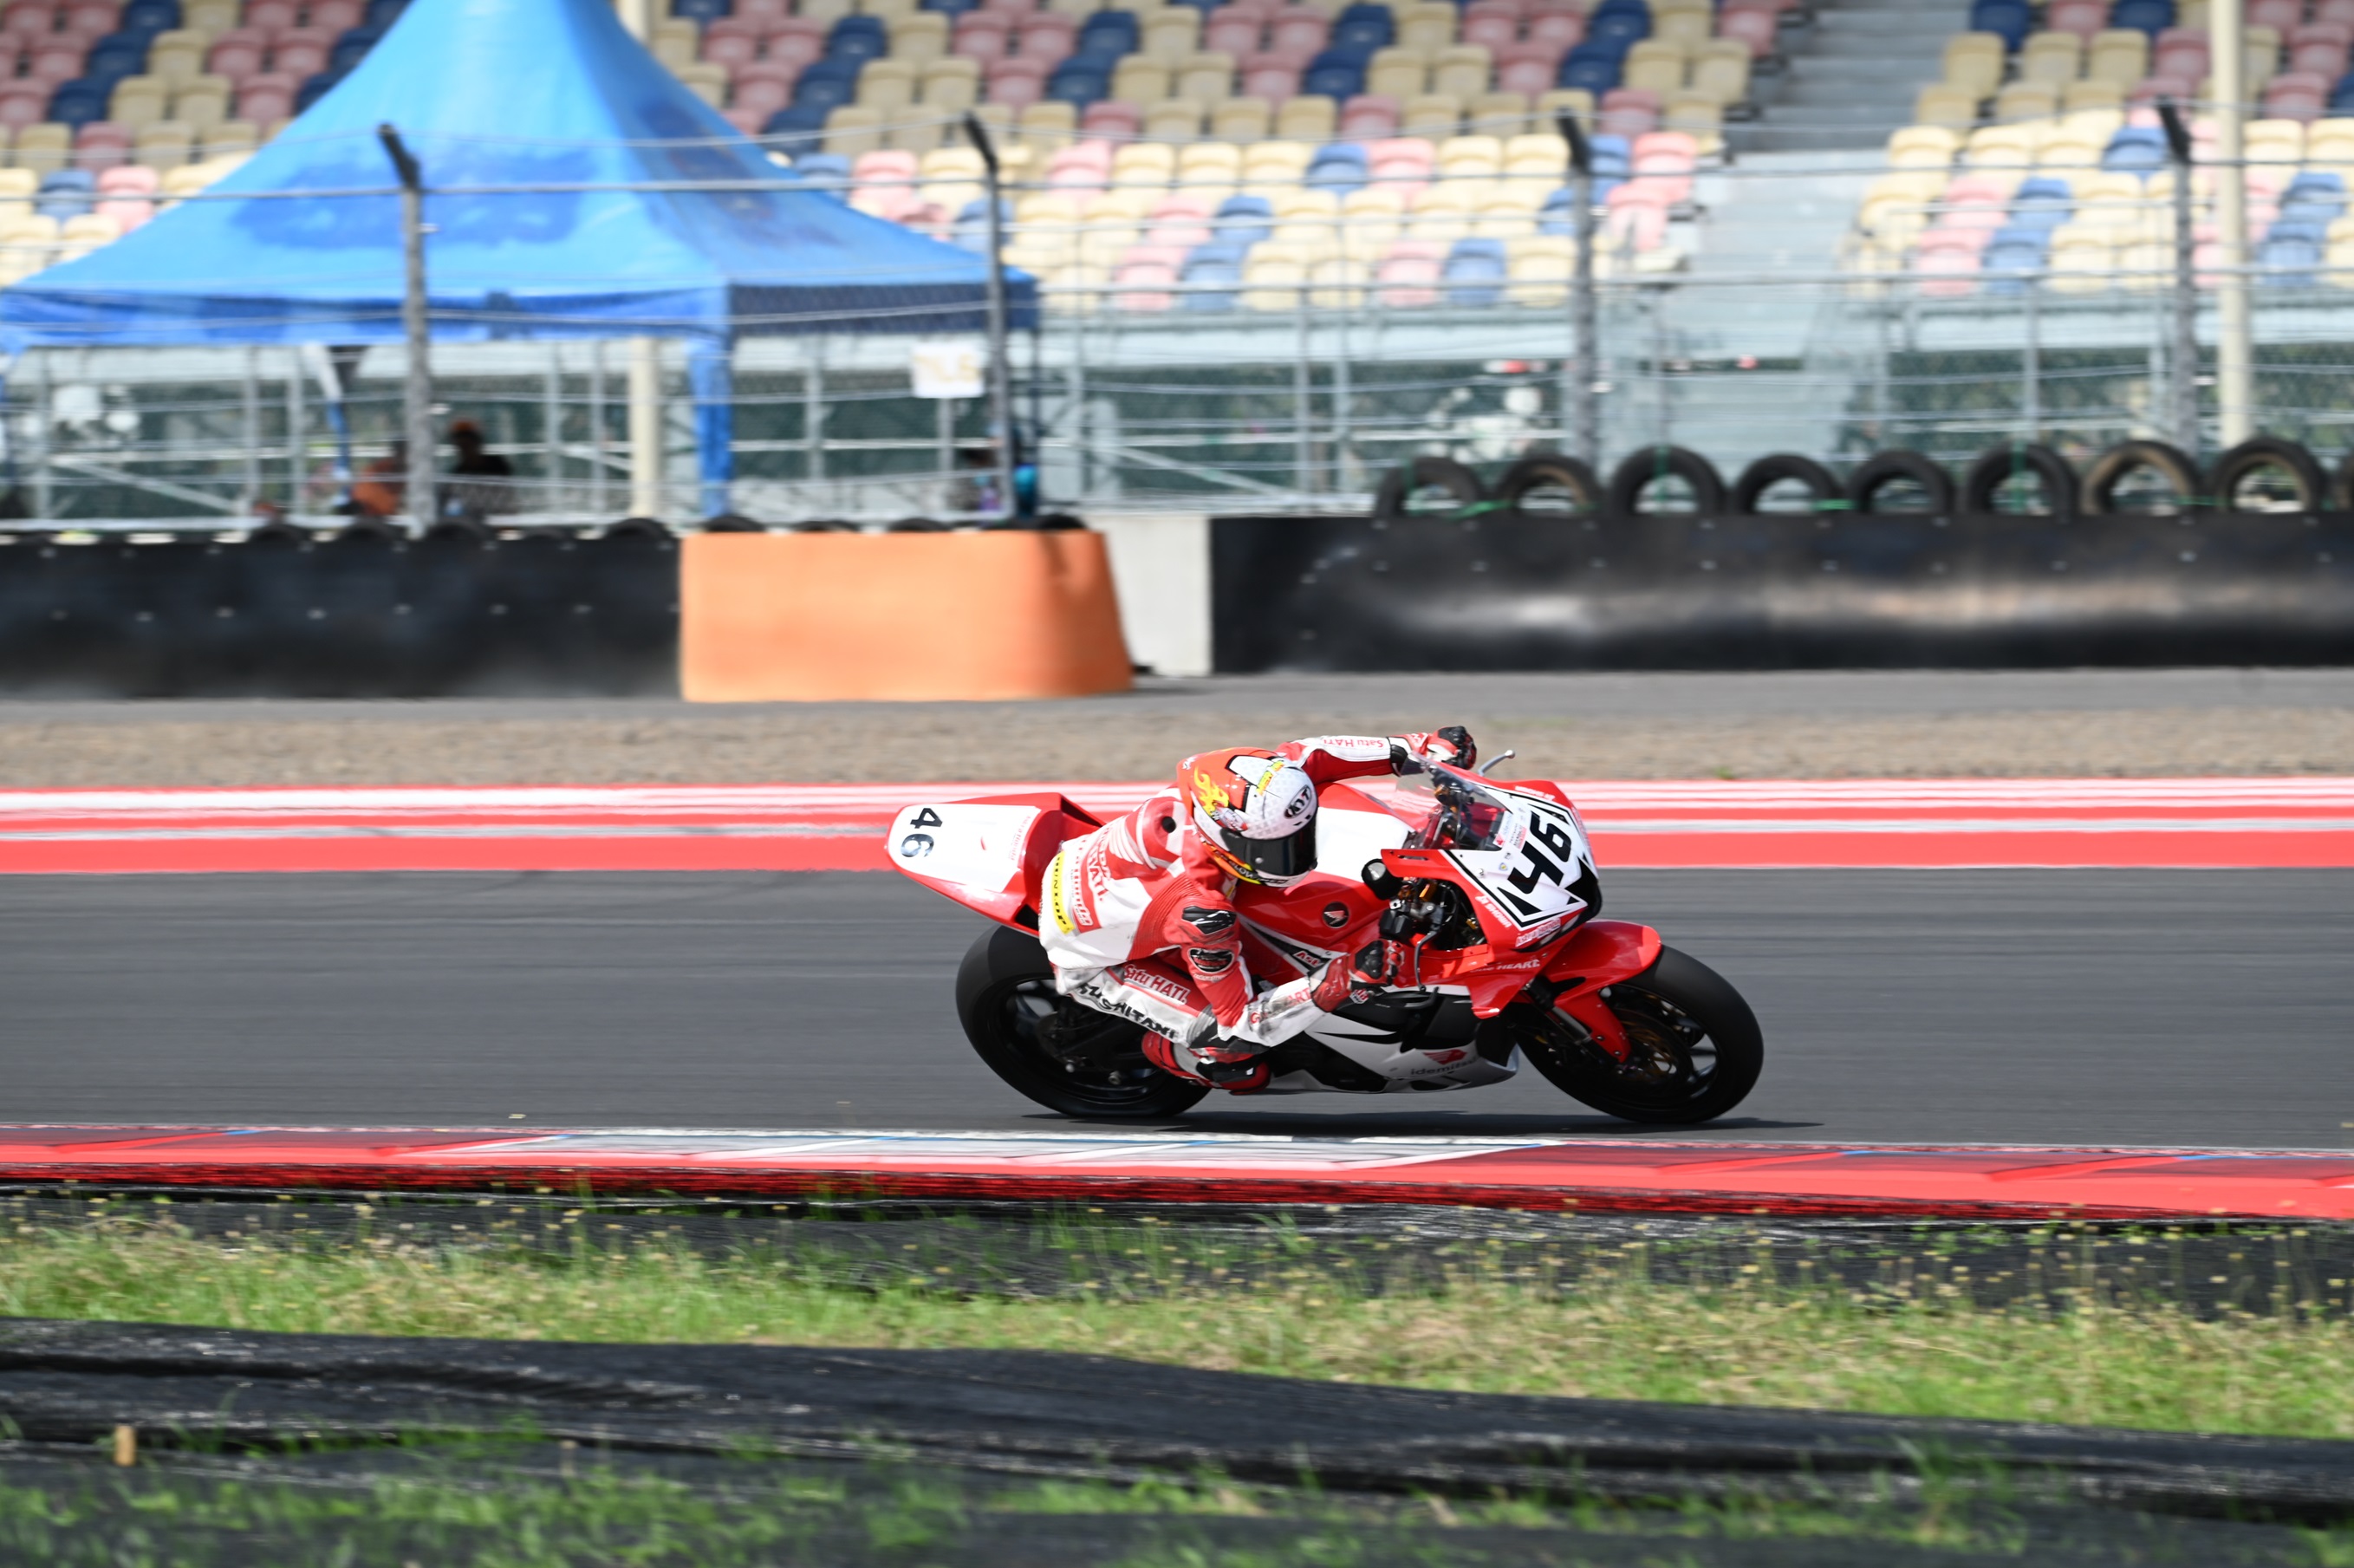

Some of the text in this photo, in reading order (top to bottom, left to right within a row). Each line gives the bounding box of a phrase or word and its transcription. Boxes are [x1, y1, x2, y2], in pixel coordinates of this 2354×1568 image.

[1358, 739, 1384, 748] Satu
[1289, 789, 1310, 816] KYT
[901, 807, 943, 858] 46
[1507, 810, 1572, 895] 46
[1124, 964, 1150, 984] Satu
